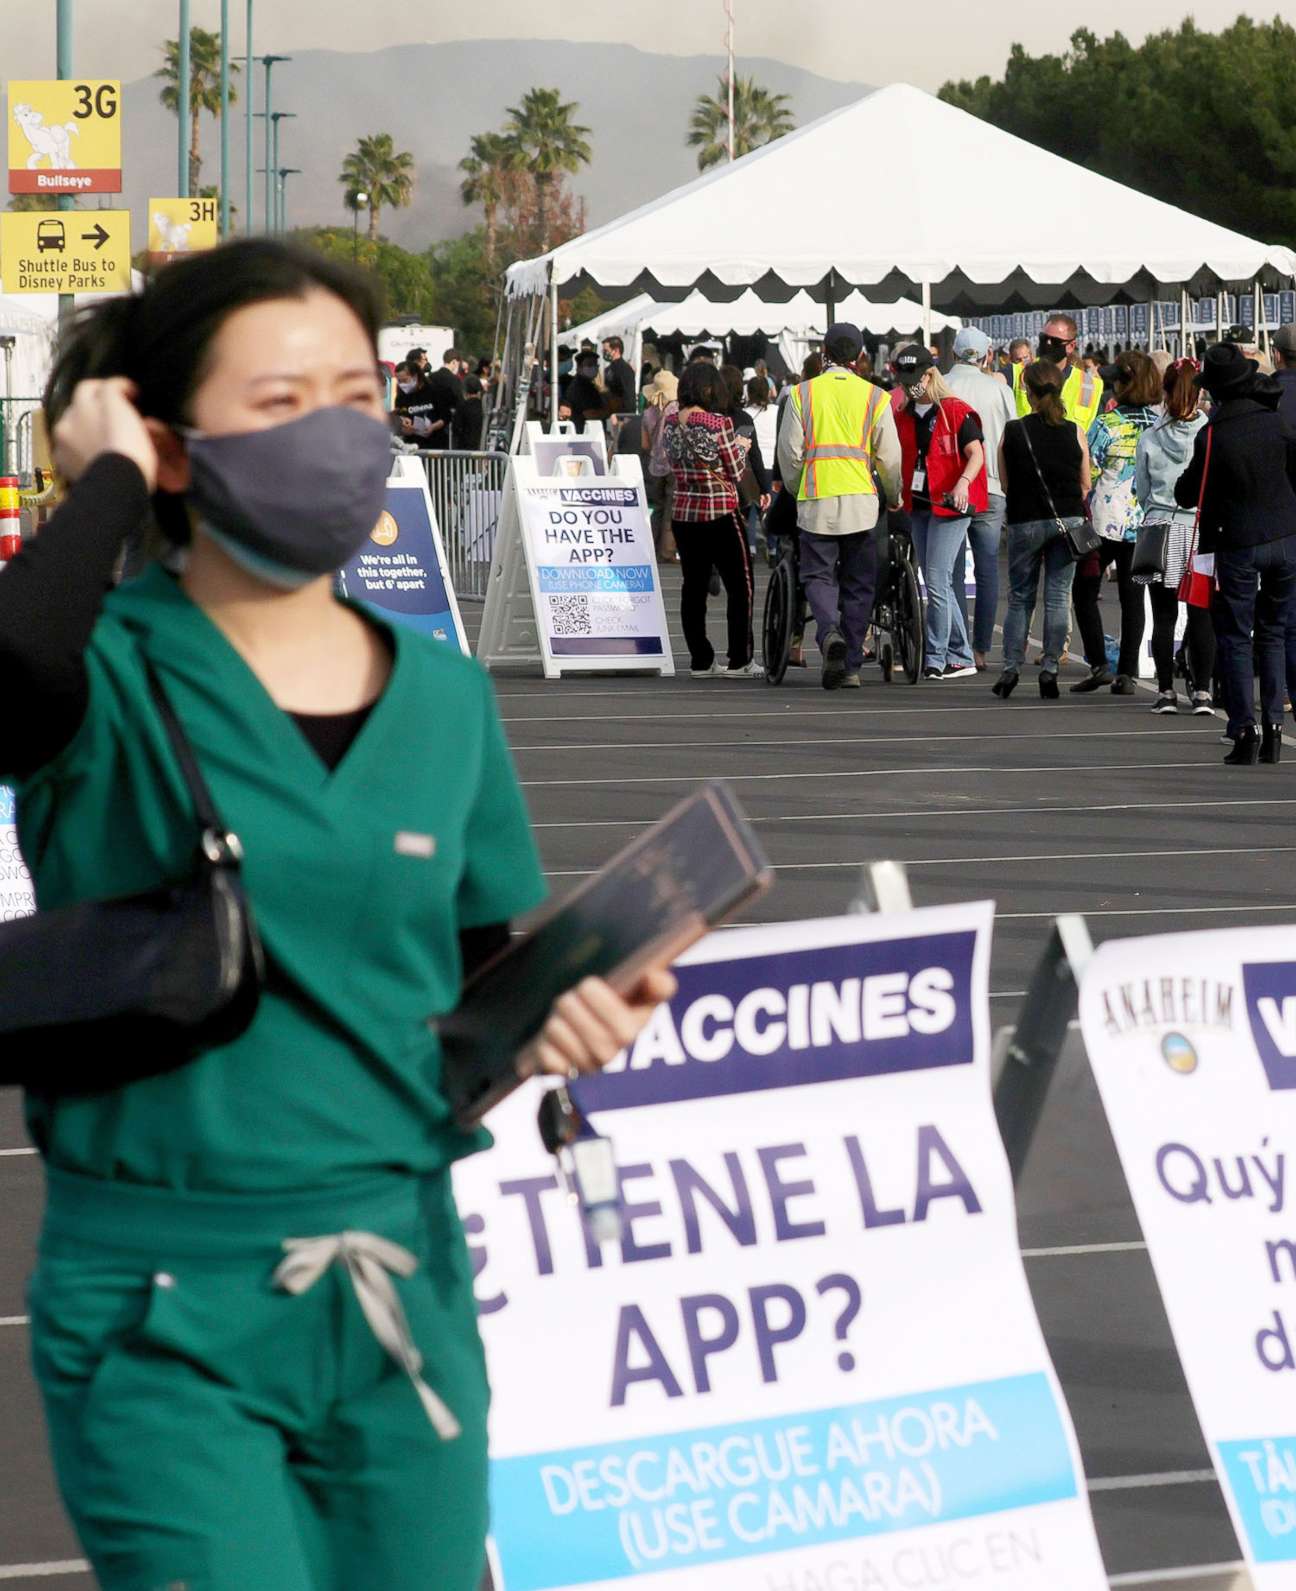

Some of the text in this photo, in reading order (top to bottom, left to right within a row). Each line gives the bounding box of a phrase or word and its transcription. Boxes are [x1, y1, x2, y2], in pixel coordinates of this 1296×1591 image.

[73, 85, 117, 119] 3G
[37, 174, 92, 189] Bullseye
[189, 202, 215, 221] 3H
[19, 258, 116, 272] Shuttle Bus to
[19, 274, 105, 290] Disney Parks
[562, 489, 634, 502] VACCINES
[549, 510, 622, 525] DO YOU
[545, 528, 635, 544] HAVE THE
[360, 554, 417, 565] We're all in
[569, 548, 614, 563] APP?
[357, 567, 427, 579] this together,
[541, 567, 648, 580] DOWNLOAD NOW
[365, 580, 385, 590] but
[396, 580, 425, 591] apart
[1102, 977, 1233, 1034] ANAHEIM
[602, 967, 956, 1073] ACCINES
[843, 1124, 983, 1230] LA
[1155, 1136, 1286, 1212] Quý
[609, 1273, 862, 1408] APP?
[539, 1397, 1000, 1517] DESCARGUE AHORA
[618, 1498, 726, 1569] (USE
